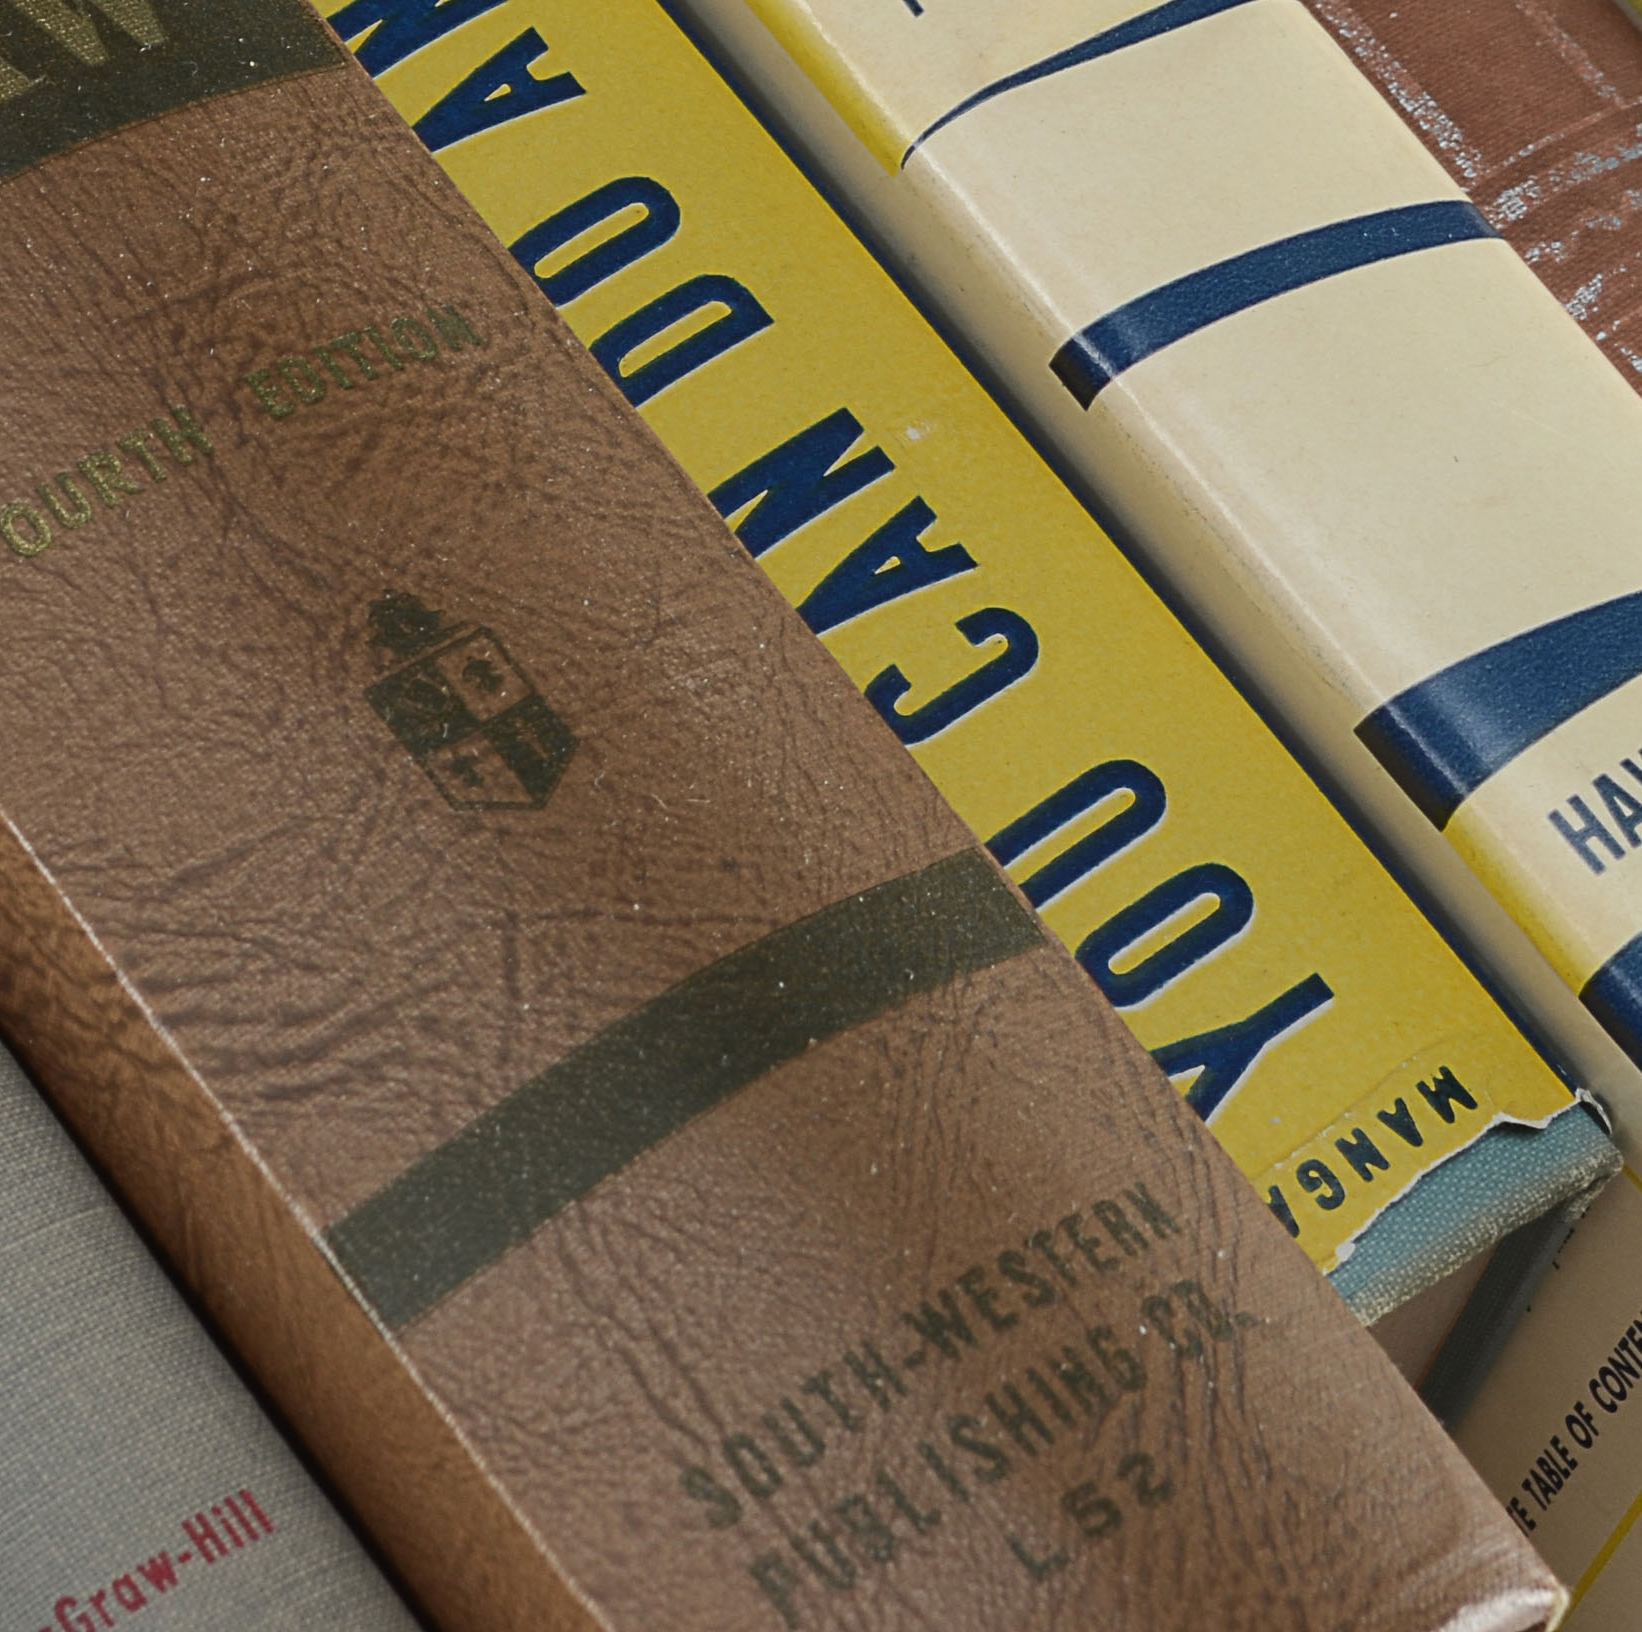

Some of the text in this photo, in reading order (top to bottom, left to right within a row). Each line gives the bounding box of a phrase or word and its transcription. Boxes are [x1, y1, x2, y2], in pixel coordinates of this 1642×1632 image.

[244, 304, 482, 420] EDITION
[507, 176, 775, 409] DO
[705, 406, 1040, 749] CAN
[982, 757, 1336, 1124] YOU
[678, 1180, 1182, 1531] SOUTH-WESTERN
[749, 1325, 1148, 1631] PUBLISHING
[1522, 1435, 1578, 1511] TABLE
[1565, 1401, 1599, 1449] OF
[39, 1488, 274, 1632] Graw-Hill
